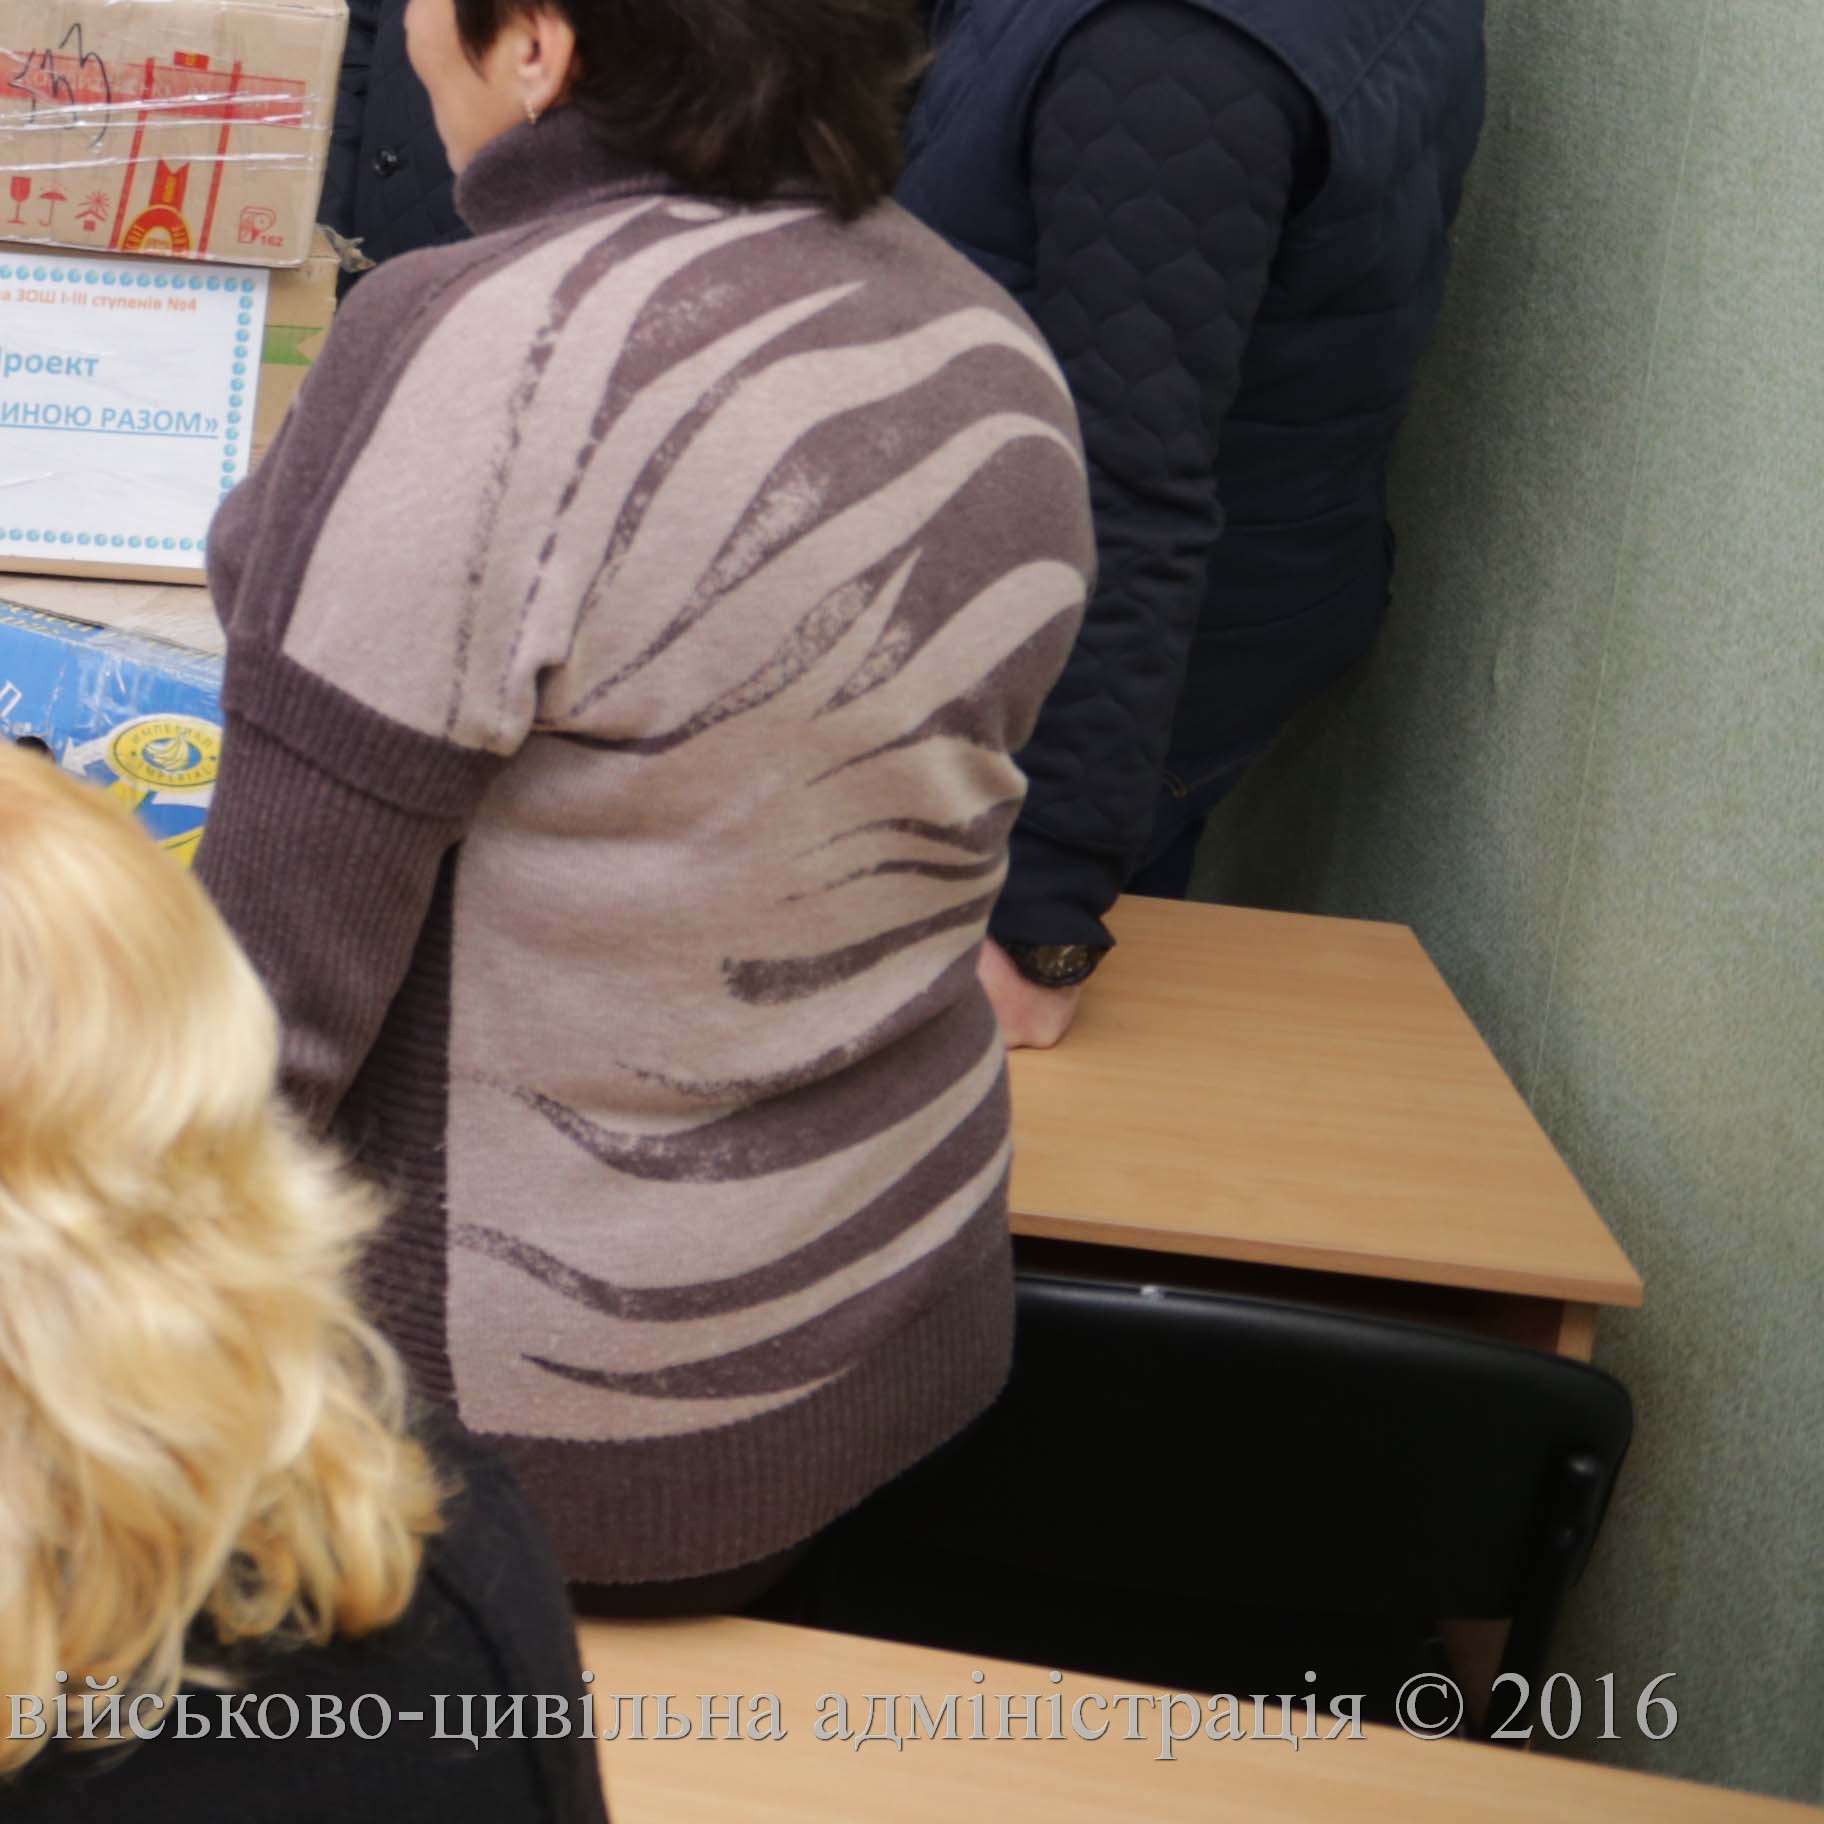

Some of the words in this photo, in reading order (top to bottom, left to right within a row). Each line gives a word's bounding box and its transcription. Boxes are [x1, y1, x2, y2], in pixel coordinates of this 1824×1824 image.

[16, 288, 55, 306] ЗОШ
[92, 293, 162, 313] ступенів
[167, 295, 197, 312] №4
[102, 407, 219, 434] РАЗОМ»
